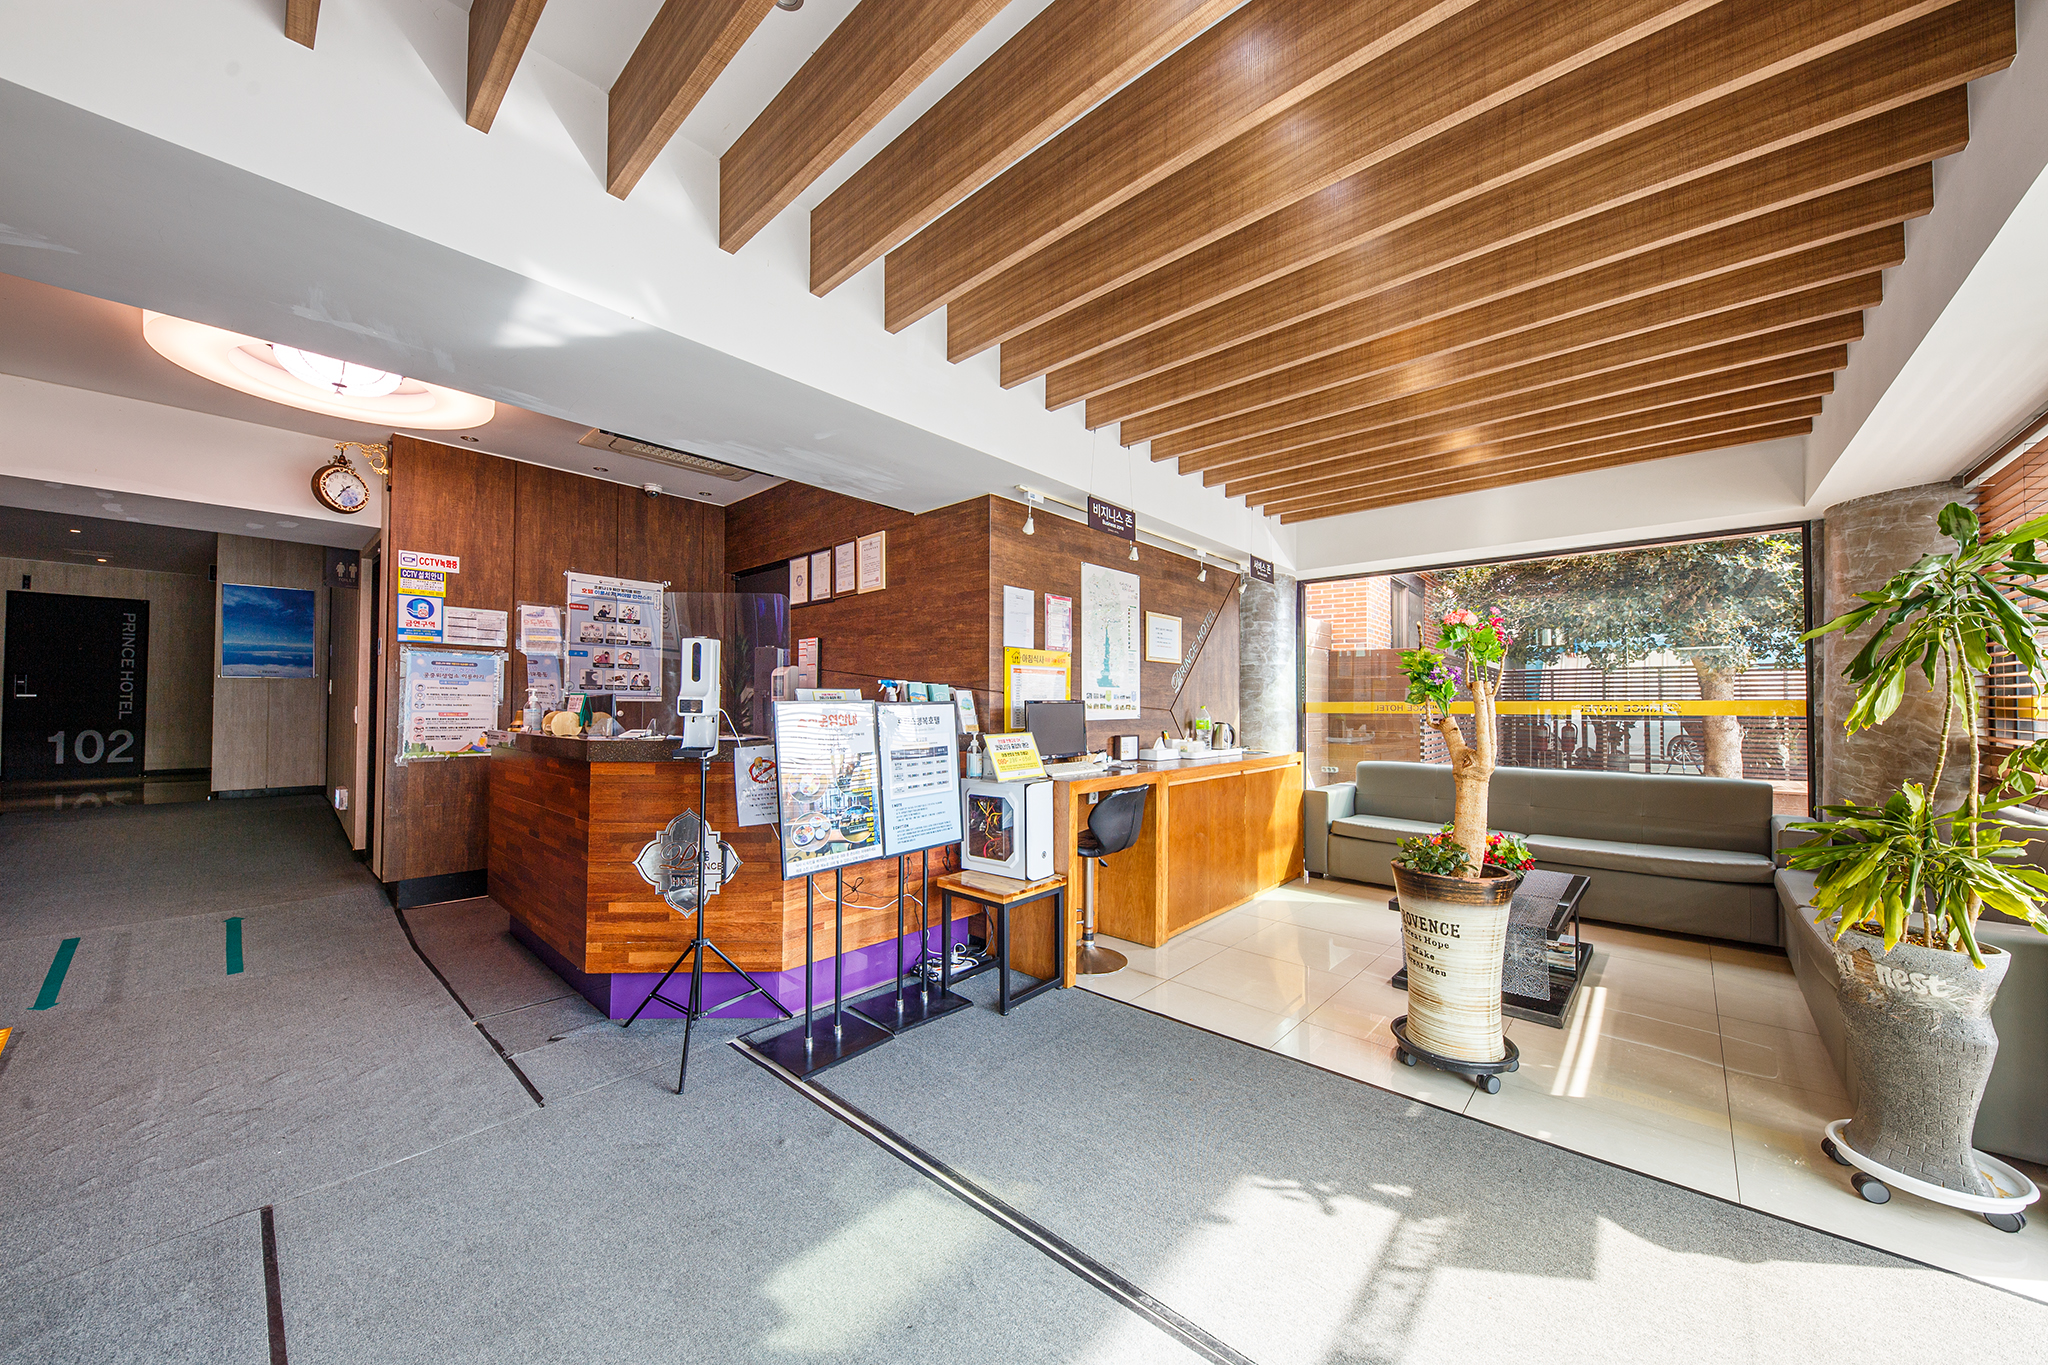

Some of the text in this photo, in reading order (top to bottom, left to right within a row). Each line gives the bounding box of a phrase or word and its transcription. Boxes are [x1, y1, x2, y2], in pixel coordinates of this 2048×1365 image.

[1093, 502, 1133, 528] 비지니스 존
[419, 556, 458, 569] CCTV녹화중
[402, 569, 443, 581] CCTV 설치안내
[405, 619, 436, 628] 금연구역
[1022, 653, 1045, 664] 아침식사
[1171, 609, 1216, 694] PRINCE HOTEL
[118, 612, 136, 719] PRINCE HOTEL
[48, 729, 134, 764] 102
[672, 877, 706, 887] HOTE
[1424, 936, 1450, 950] Hope
[1411, 944, 1435, 961] Make
[1426, 964, 1447, 977] Men
[1875, 963, 1950, 998] nest
